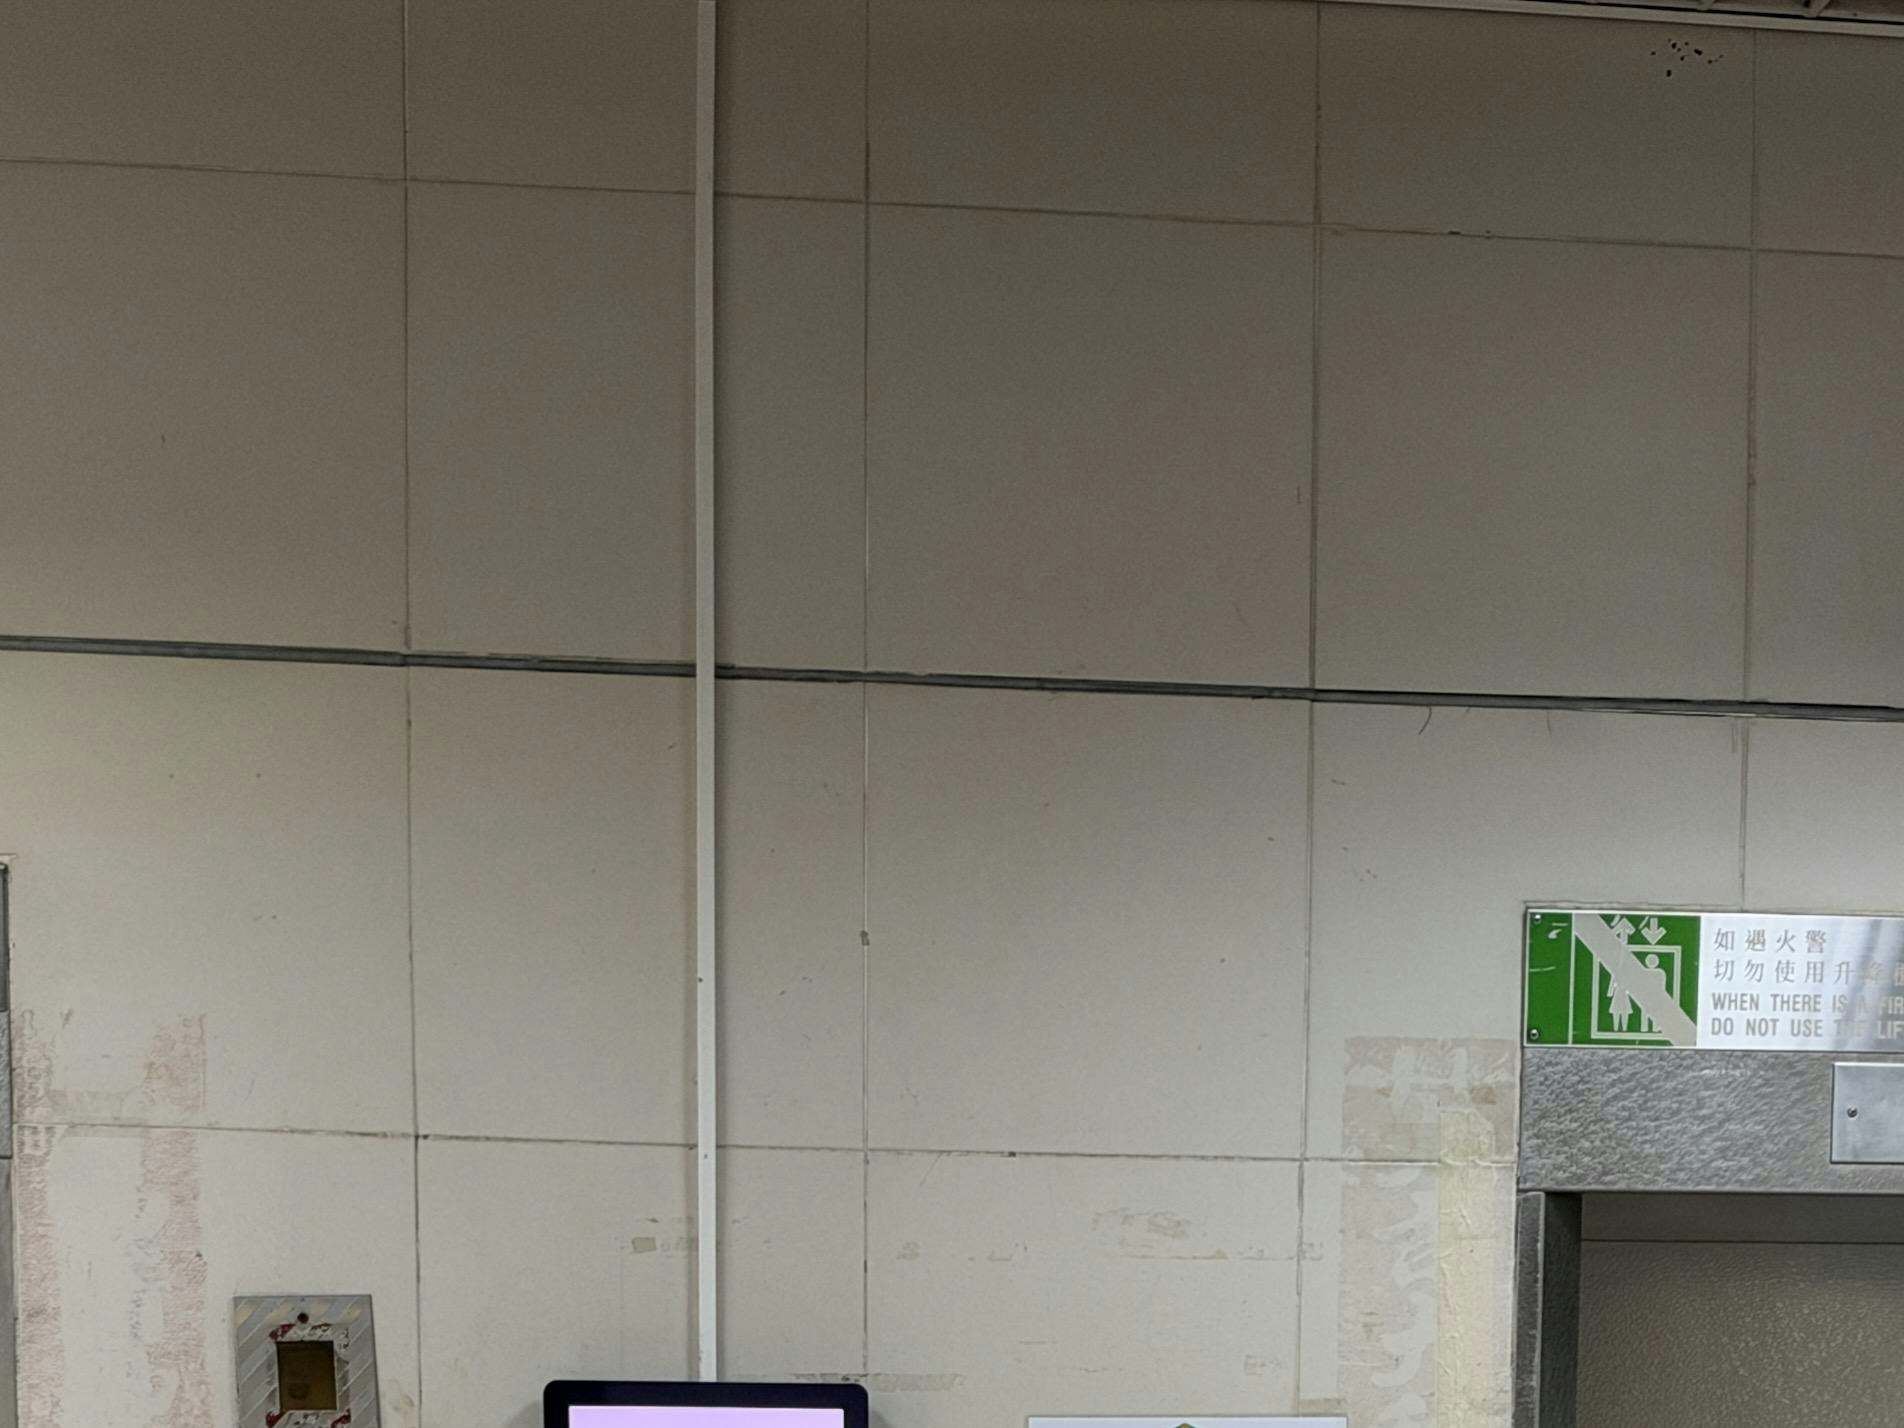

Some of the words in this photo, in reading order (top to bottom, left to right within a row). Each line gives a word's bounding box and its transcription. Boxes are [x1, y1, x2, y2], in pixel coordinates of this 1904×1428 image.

[1714, 928, 1827, 953] 如遇火警
[1712, 993, 1759, 1011] WHEN
[1770, 994, 1821, 1012] THERE
[1711, 1018, 1734, 1036] DO
[1746, 1018, 1779, 1036] NOT
[1791, 1019, 1823, 1037] USE
